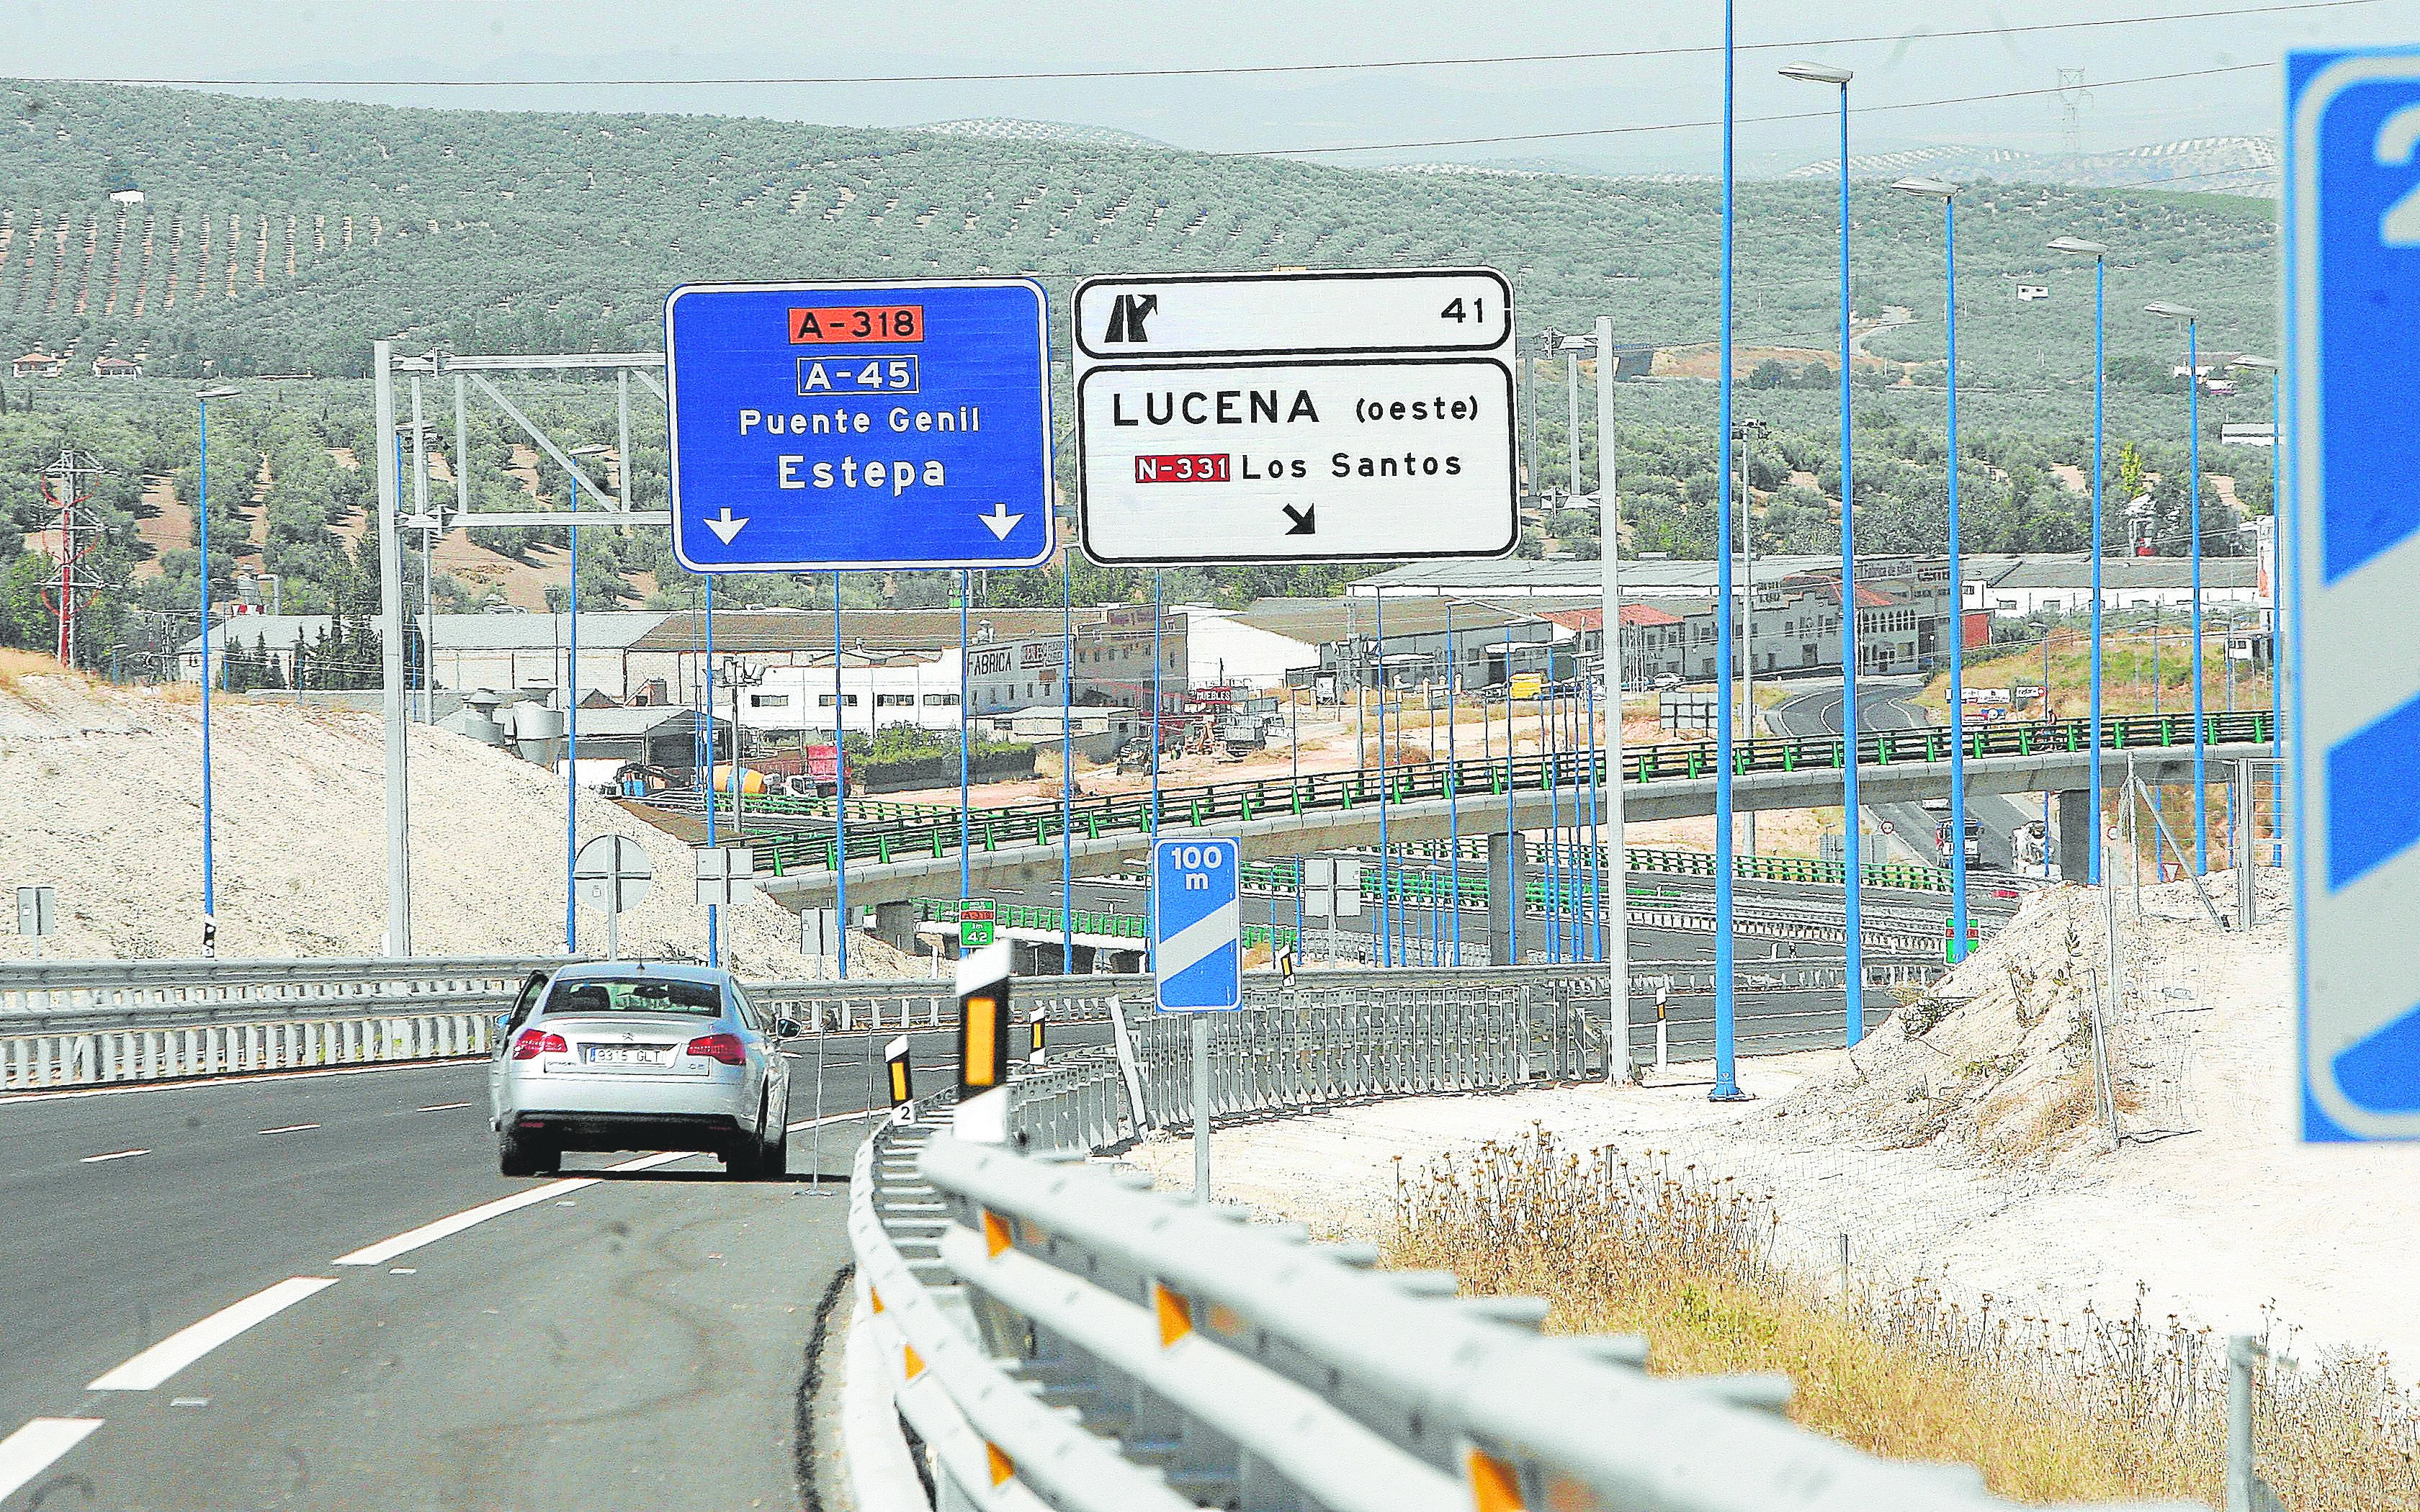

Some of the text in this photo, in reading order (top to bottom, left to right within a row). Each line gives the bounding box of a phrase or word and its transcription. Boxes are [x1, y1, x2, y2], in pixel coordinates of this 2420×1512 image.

[1440, 297, 1484, 323] 41
[797, 310, 915, 340] A-318
[805, 361, 910, 390] A-45
[740, 406, 980, 436] Puente Genil
[1113, 390, 1478, 426] LUCENA (oeste)
[779, 455, 945, 498] Estepa
[1138, 452, 1462, 481] N-331 Los Santos
[1196, 690, 1231, 701] MUEBLES
[1171, 846, 1222, 870] 100
[1186, 873, 1209, 890] m
[967, 931, 987, 942] 42
[900, 1106, 910, 1120] 2
